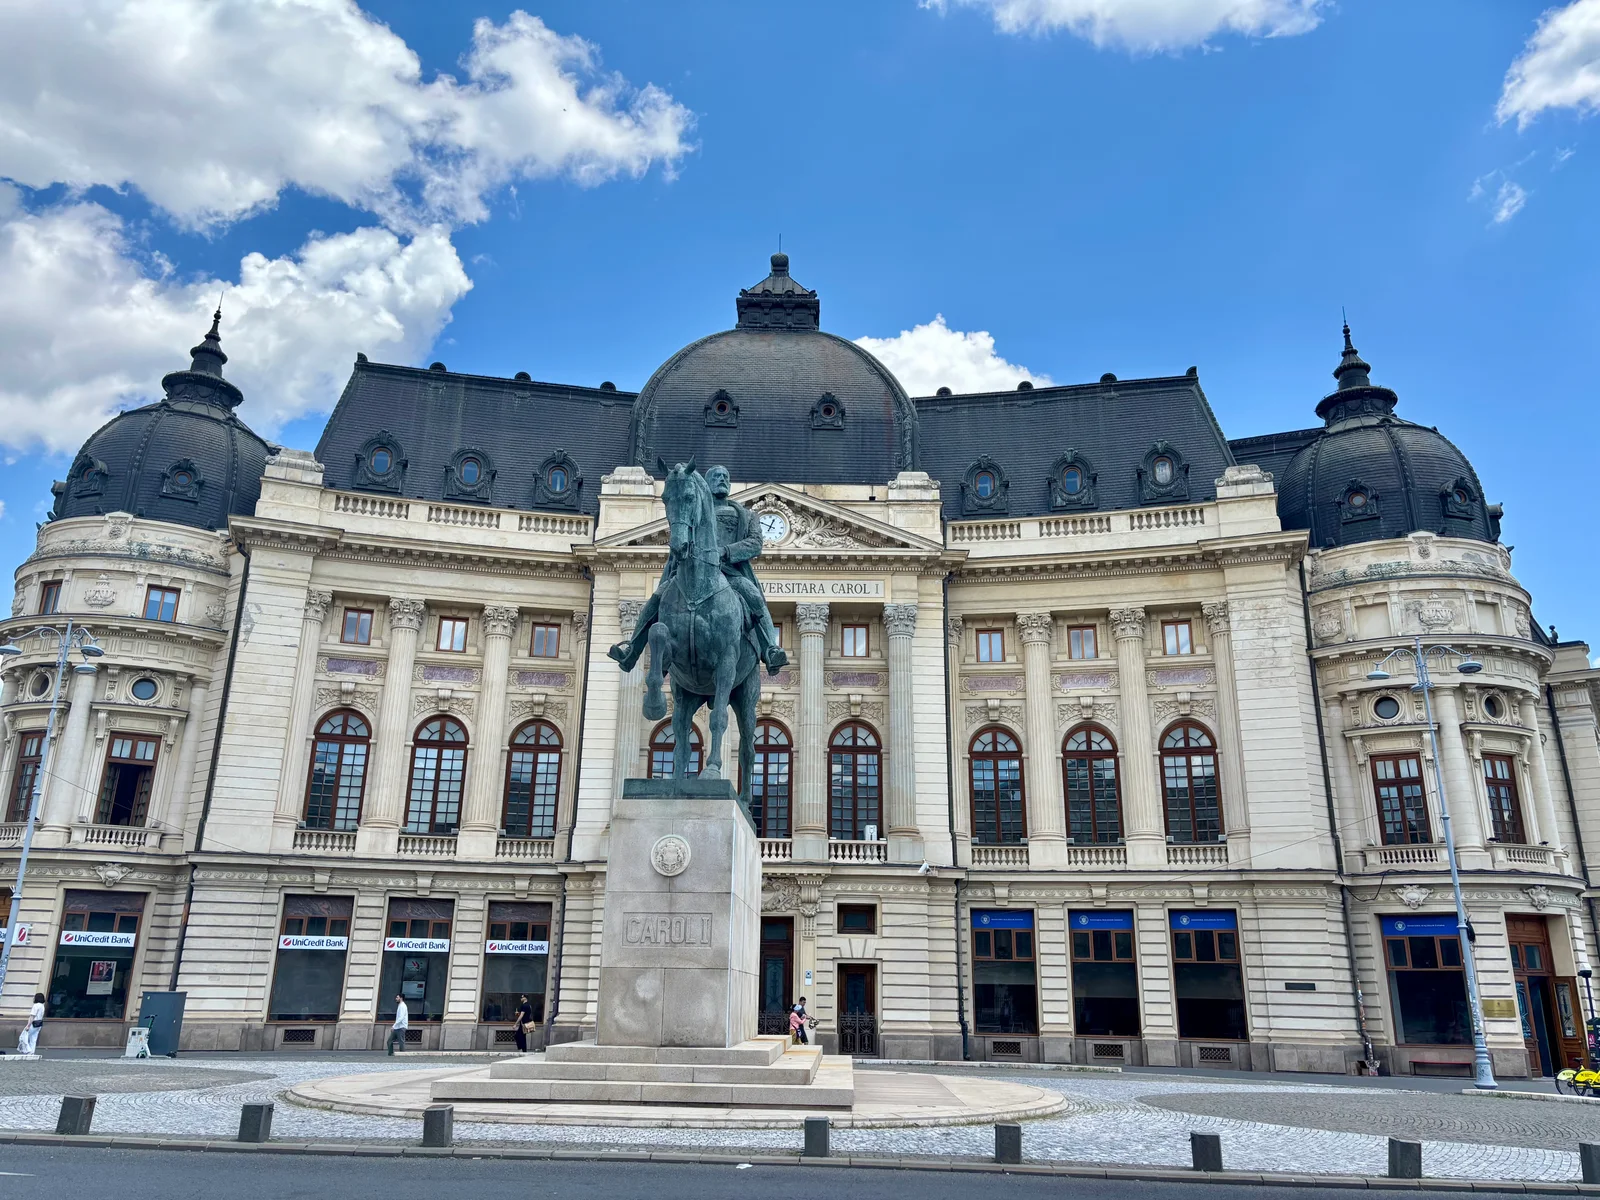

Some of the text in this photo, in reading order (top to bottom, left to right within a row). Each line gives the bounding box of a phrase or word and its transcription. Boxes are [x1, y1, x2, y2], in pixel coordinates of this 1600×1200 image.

[761, 582, 879, 594] VERSITARA CAROL I
[626, 916, 709, 944] CAROL I
[74, 934, 131, 944] UniCredit Bank
[292, 938, 344, 947] UniCredit Bank
[396, 940, 446, 949] UniCredit Bank
[497, 943, 545, 951] UniCredit Bank
